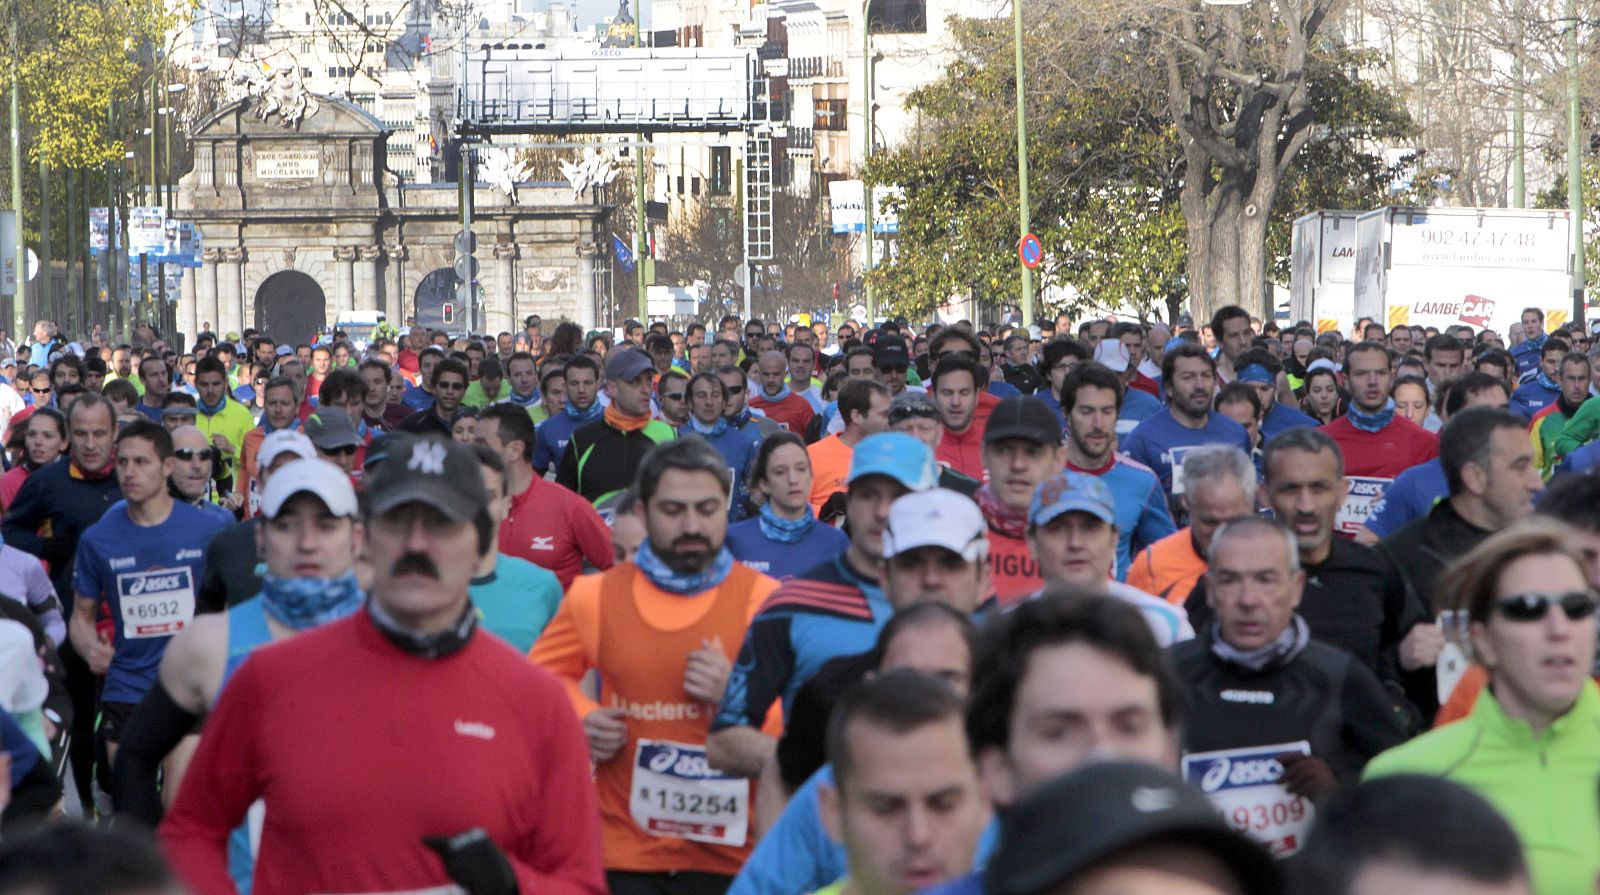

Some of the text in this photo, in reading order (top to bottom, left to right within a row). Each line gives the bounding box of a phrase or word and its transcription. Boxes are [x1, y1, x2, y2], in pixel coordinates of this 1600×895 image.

[1421, 229, 1536, 248] 902 47 47 48
[138, 601, 180, 618] 6932
[657, 789, 738, 815] 13254
[1233, 797, 1305, 831] 9309
